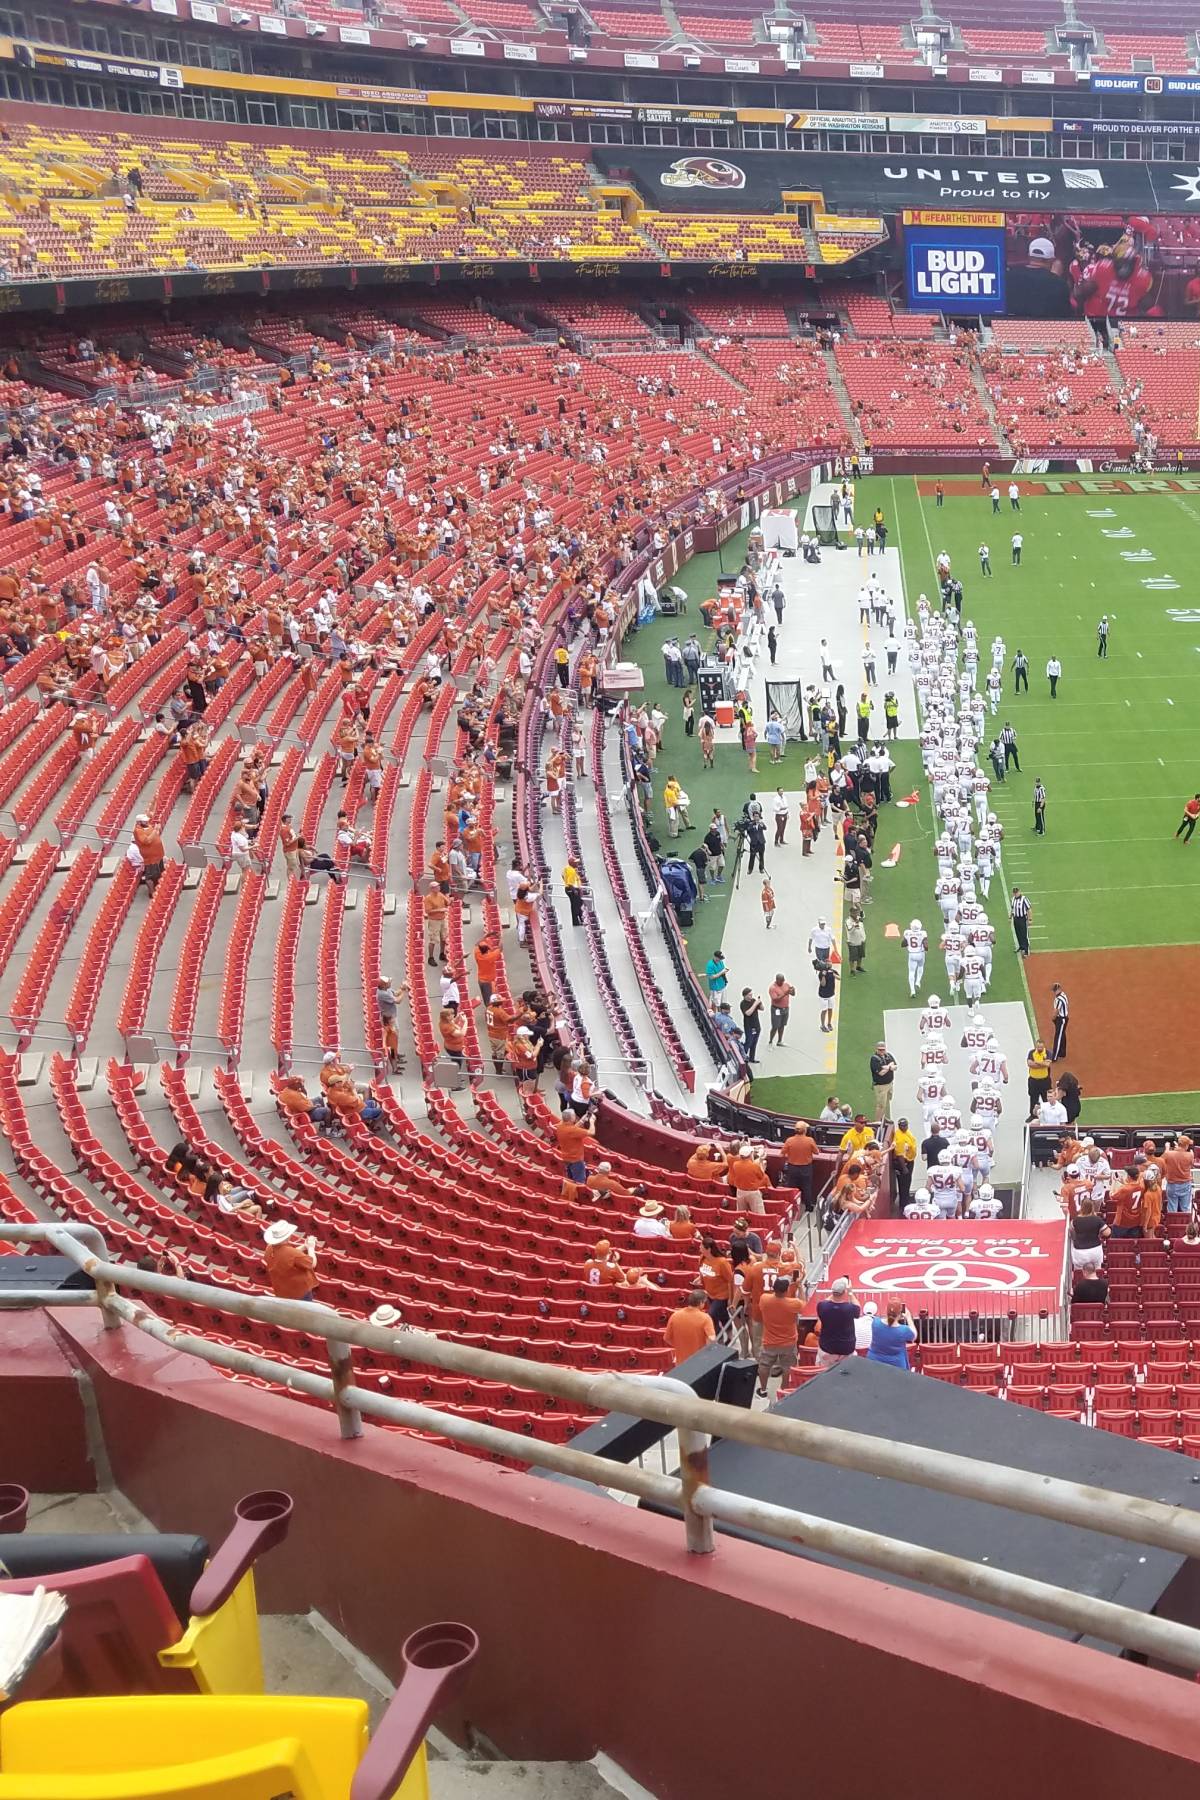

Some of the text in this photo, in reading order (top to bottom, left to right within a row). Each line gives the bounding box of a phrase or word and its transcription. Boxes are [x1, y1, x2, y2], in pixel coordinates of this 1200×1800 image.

[1095, 79, 1139, 89] BUD LIGHT
[1146, 80, 1160, 90] 40
[1168, 82, 1186, 90] BUD
[646, 114, 672, 122] SALUTE
[1063, 123, 1082, 131] FedEx
[1093, 123, 1120, 133] PROUD
[1120, 124, 1130, 133] TO
[1131, 125, 1162, 134] DELIVER
[1163, 125, 1179, 134] FOR
[1179, 126, 1193, 134] THE
[883, 167, 1052, 185] UNITED
[939, 187, 1051, 200] Proud to fly
[924, 212, 997, 224] #FEARTHETURTLE
[927, 250, 985, 272] BUD
[917, 272, 994, 295] LIGHT
[995, 646, 1001, 655] 7
[924, 735, 936, 745] 49
[962, 737, 974, 748] 78
[934, 771, 947, 781] 52
[958, 766, 971, 776] 73
[975, 782, 987, 791] 86
[945, 808, 959, 817] 30
[960, 821, 968, 831] 7
[938, 846, 950, 856] 21
[963, 870, 971, 881] 5
[942, 884, 957, 895] 94
[962, 908, 978, 919] 56
[972, 930, 988, 942] 42
[910, 937, 918, 948] 6
[945, 939, 961, 951] 53
[965, 963, 979, 975] 15
[928, 1015, 943, 1029] 19
[967, 1033, 986, 1047] 55
[926, 1050, 944, 1064] 85
[981, 1058, 997, 1073] 71
[927, 1085, 938, 1098] 8
[976, 1096, 995, 1111] 29
[937, 1116, 957, 1130] 39
[952, 1154, 971, 1169] 17
[933, 1174, 955, 1189] 54
[1131, 1190, 1142, 1210] 7
[984, 1238, 1033, 1246] Let's
[854, 1245, 1050, 1258] TOYOTA
